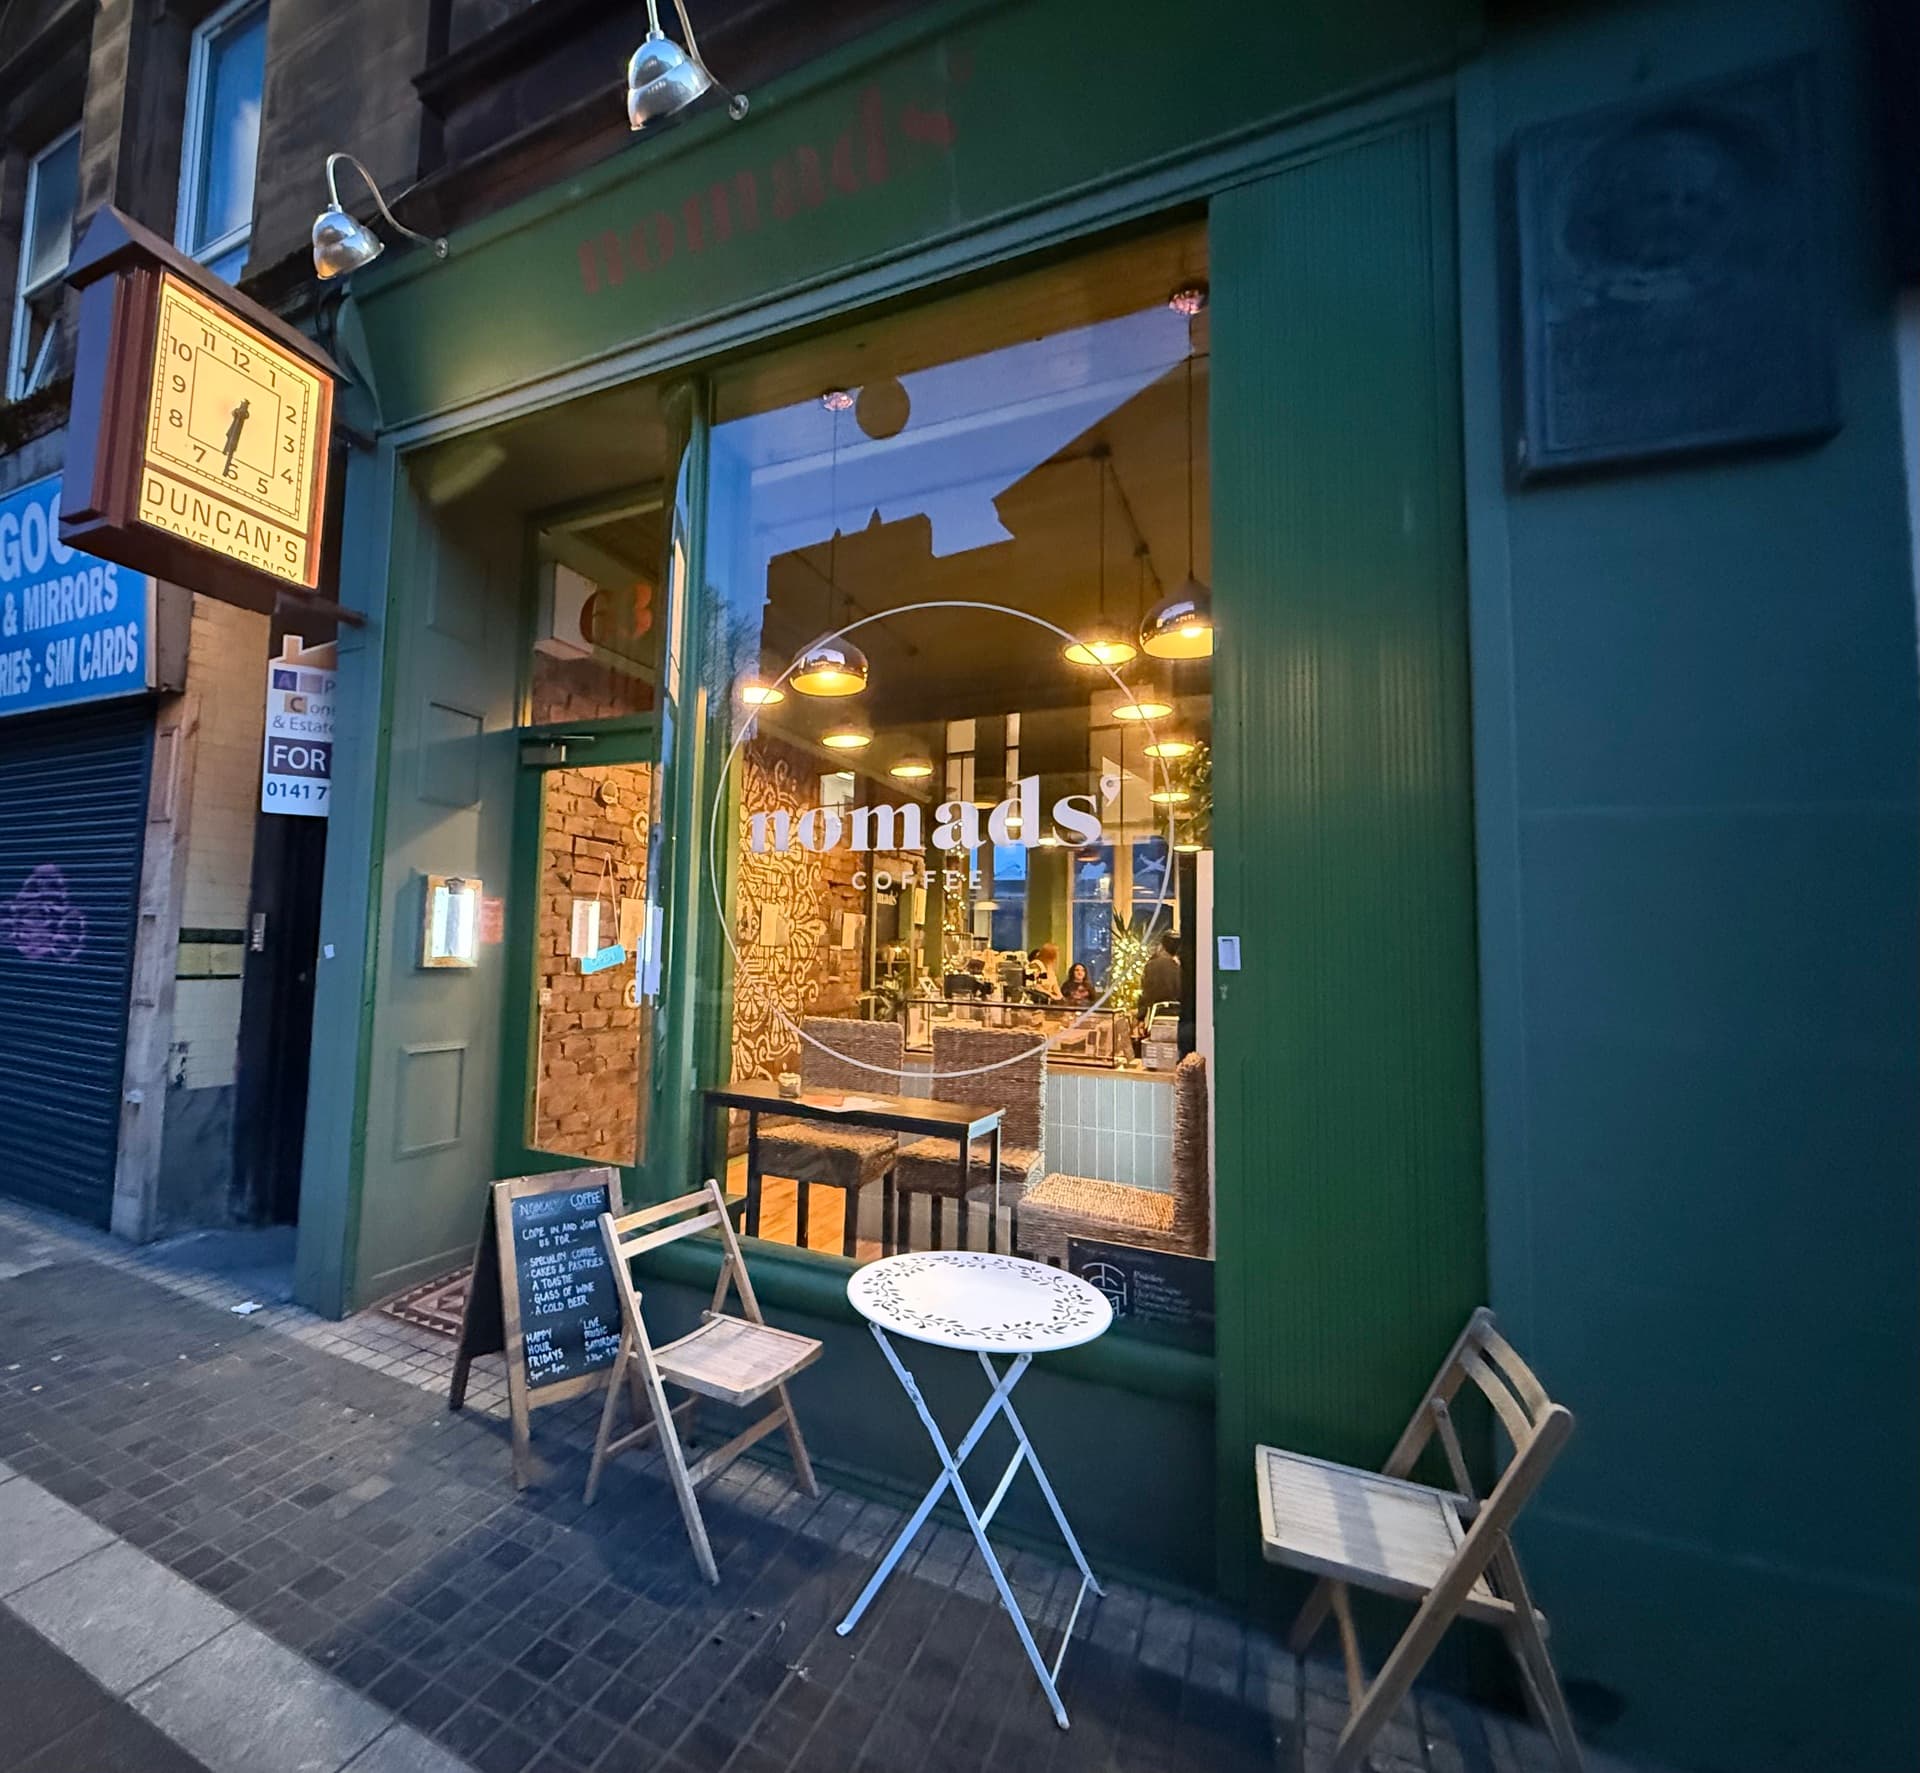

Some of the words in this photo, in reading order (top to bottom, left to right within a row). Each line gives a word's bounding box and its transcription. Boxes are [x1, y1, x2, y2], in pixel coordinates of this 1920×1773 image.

[170, 336, 192, 361] 10
[201, 328, 216, 351] 11
[232, 347, 251, 373] 12
[172, 375, 186, 393] 9
[269, 370, 276, 388] 1
[169, 409, 183, 428] 8
[285, 406, 297, 424] 2
[193, 444, 206, 463] 7
[283, 435, 295, 453] 3
[256, 477, 268, 494] 5
[280, 468, 294, 485] 4
[146, 478, 298, 564] DUNCAN'S
[3, 592, 18, 638] &
[23, 562, 119, 633] MIRRORS
[44, 637, 76, 689] SIM
[79, 621, 139, 682] CARDS
[273, 715, 285, 729] &
[273, 745, 326, 772] FOR
[267, 782, 310, 800] 0141
[750, 774, 1121, 853] nomads'
[852, 870, 983, 890] COFFEE
[531, 1265, 557, 1279] CAKES
[532, 1280, 539, 1292] A
[534, 1290, 561, 1306] GLASS
[563, 1286, 572, 1298] OF
[576, 1282, 596, 1294] WINE
[535, 1306, 542, 1317] A
[543, 1302, 564, 1314] COLD
[567, 1295, 589, 1309] BEER
[583, 1316, 600, 1330] LIVE
[526, 1328, 552, 1345] HAPPY
[528, 1341, 552, 1355] HOUR
[528, 1348, 564, 1369] FRIDAYS
